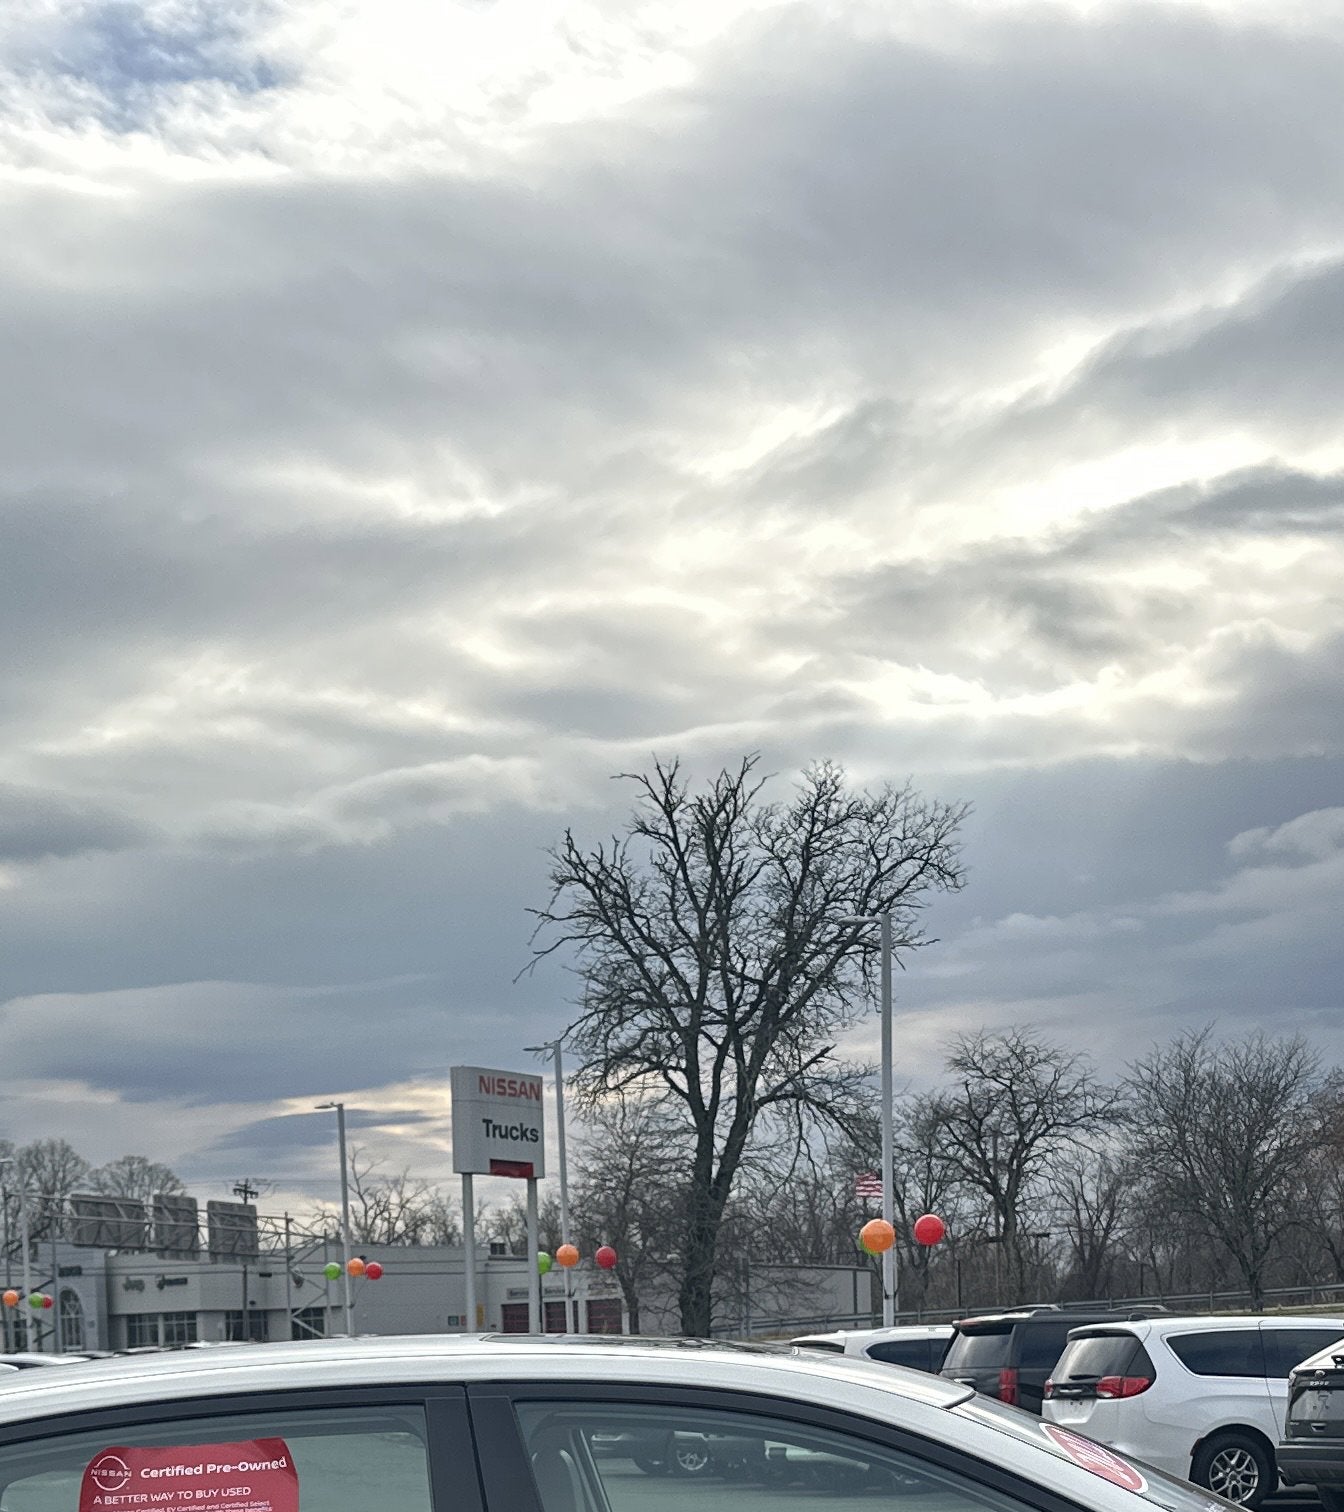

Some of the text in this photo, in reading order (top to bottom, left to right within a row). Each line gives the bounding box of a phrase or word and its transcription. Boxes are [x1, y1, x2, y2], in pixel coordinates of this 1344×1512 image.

[478, 1075, 541, 1101] NISSAN
[481, 1118, 539, 1143] Trucks
[90, 1468, 132, 1478] NISSAN
[140, 1456, 288, 1479] Certified Pre-Owned
[93, 1486, 252, 1505] A BETTER WAY TO BUY USED
